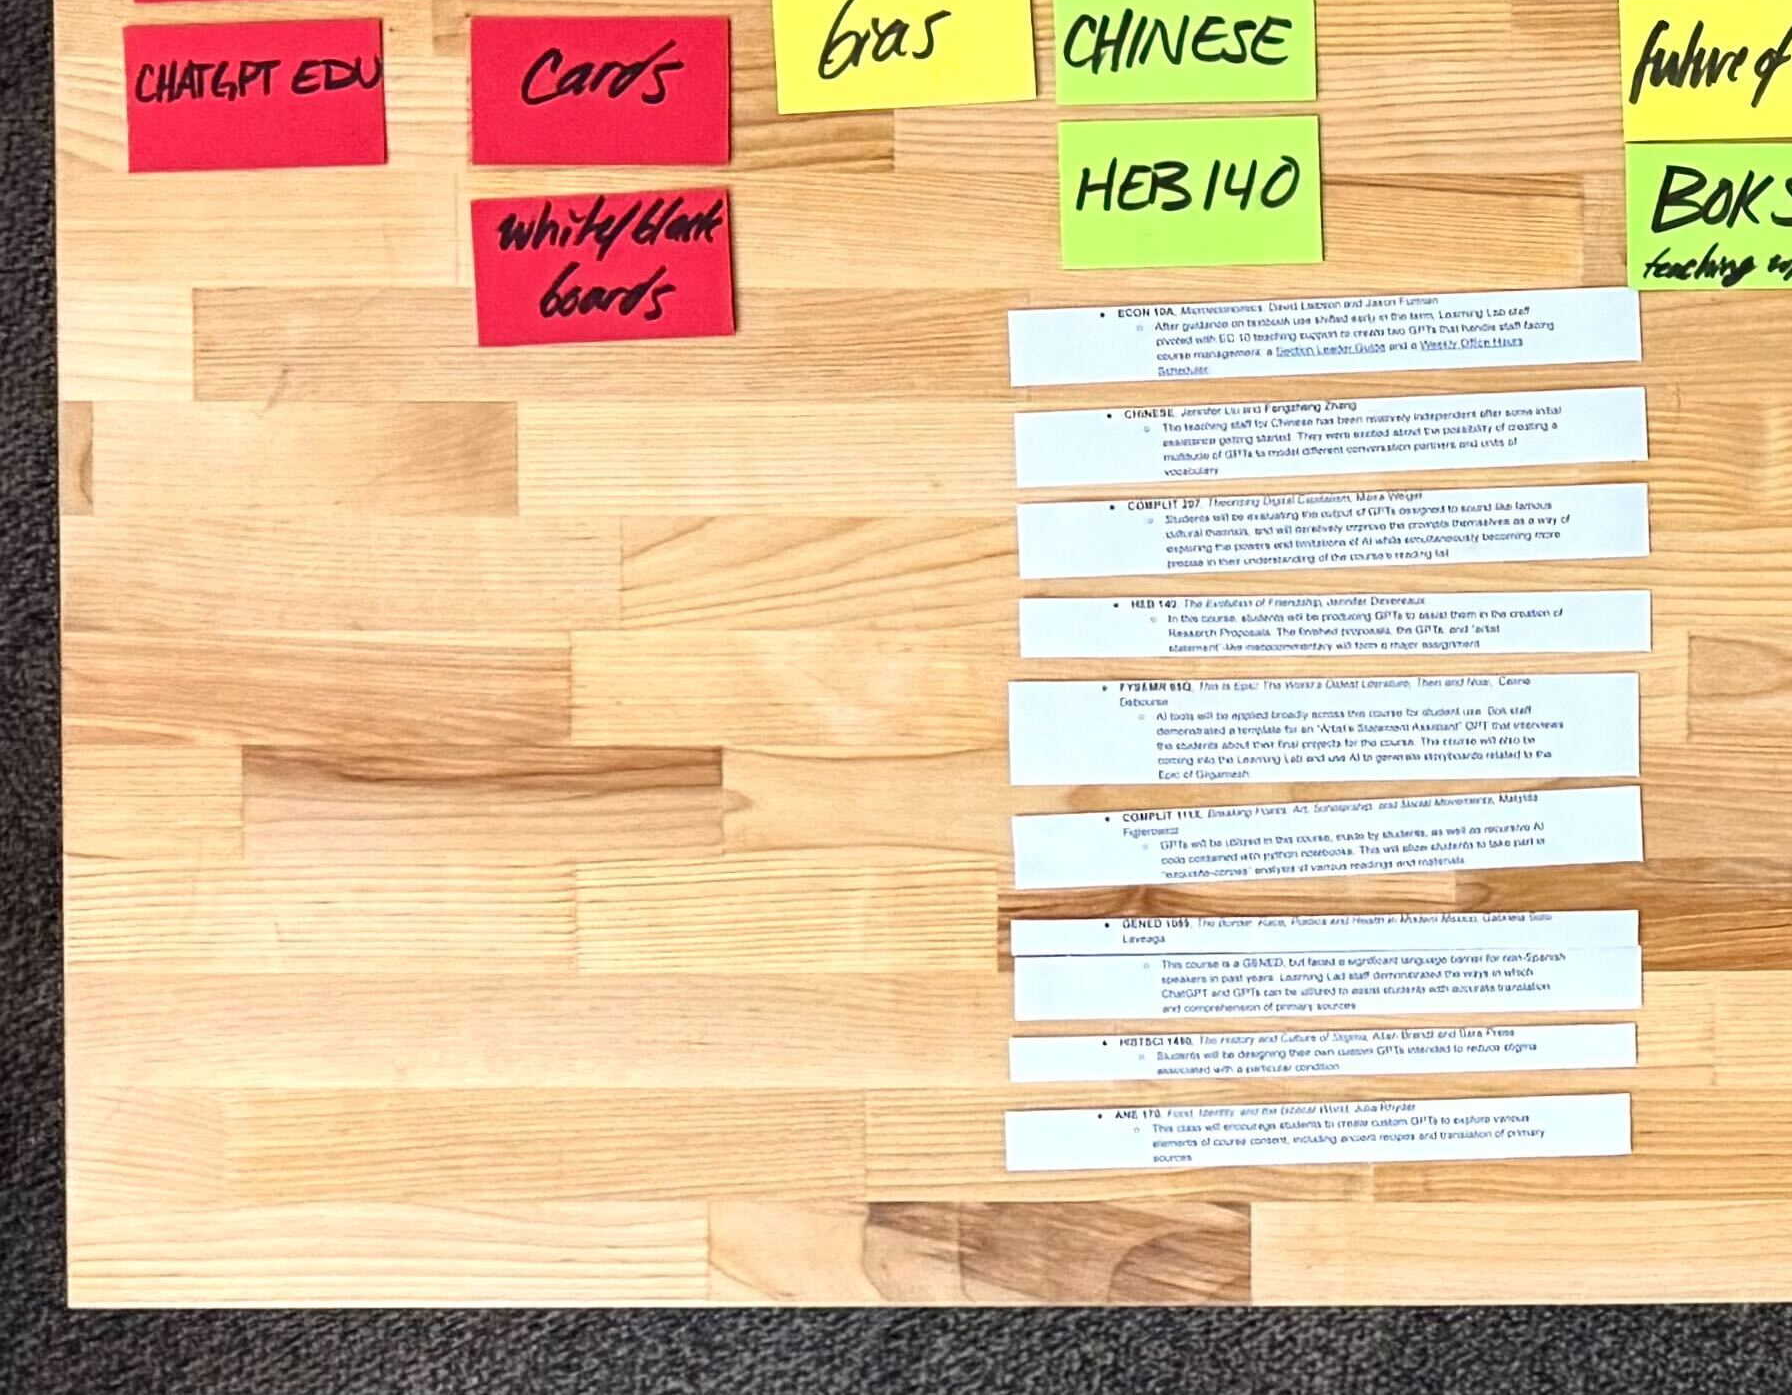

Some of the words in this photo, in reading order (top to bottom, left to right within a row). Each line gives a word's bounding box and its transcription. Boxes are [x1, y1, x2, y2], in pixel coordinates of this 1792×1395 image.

[1063, 7, 1292, 73] CHINESE
[1629, 20, 1748, 104] future
[137, 61, 277, 100] CHATGPT
[293, 60, 383, 93] EDU
[1650, 165, 1774, 233] BOK
[539, 261, 676, 320] boards
[1643, 243, 1756, 287] teaching
